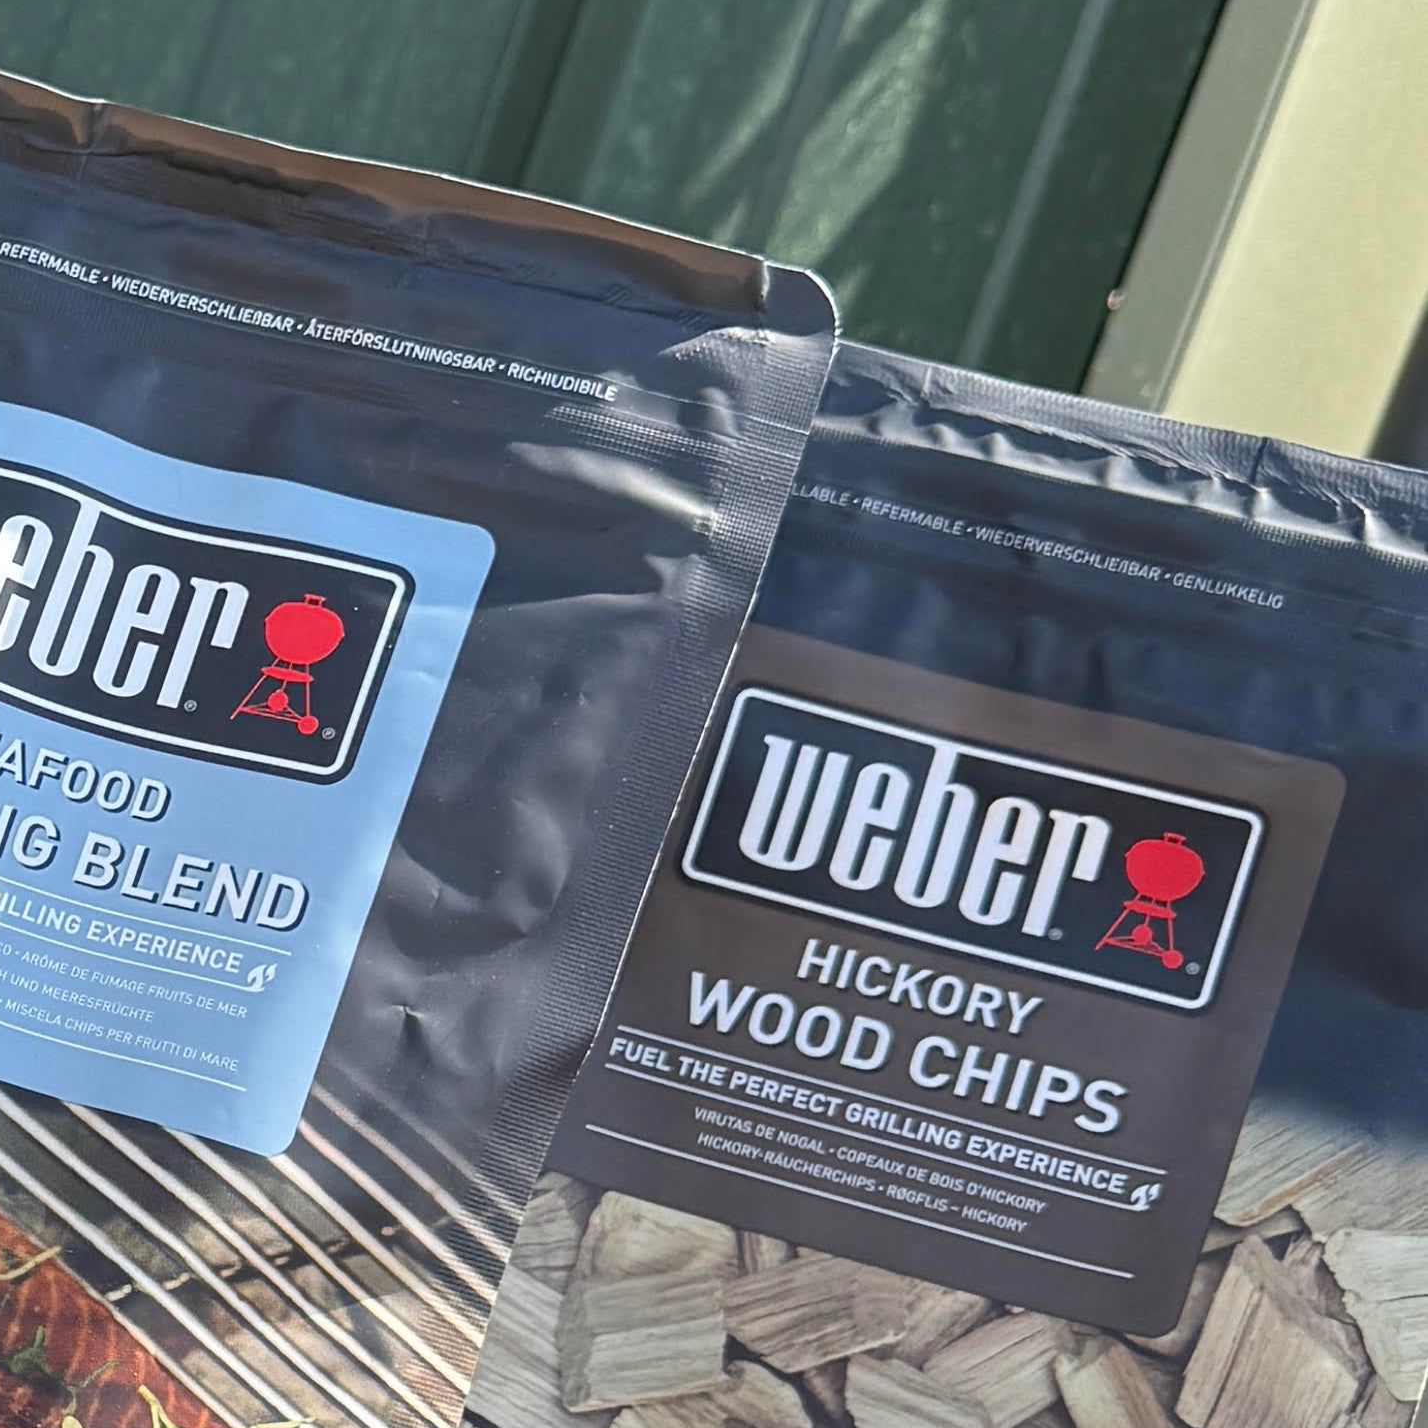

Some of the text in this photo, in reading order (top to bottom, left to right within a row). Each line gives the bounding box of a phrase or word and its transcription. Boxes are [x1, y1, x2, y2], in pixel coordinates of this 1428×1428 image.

[303, 318, 494, 373] ÅTERFÖRSLUTNINGSBAR
[506, 363, 618, 401] RICHIUDIBILE
[861, 497, 963, 535] REFERMABLE
[1172, 572, 1283, 608] GENLUKKELIG
[72, 830, 309, 935] BLEND
[738, 734, 1113, 940] weber
[85, 916, 243, 976] EXPERIENCE
[795, 937, 1044, 1036] HICKORY
[687, 969, 1130, 1137] WOOD CHIPS
[609, 1036, 1126, 1194] FUEL THE PERFECT GRILLING EXPERIENCE
[693, 1105, 1045, 1213] VIRUTAS DE NOGAL COPEAUX DE BOIS D'HICKORY
[697, 1131, 1027, 1233] HICKORY-RÄUCHERCHIPS RØGFLIS HICKORY
